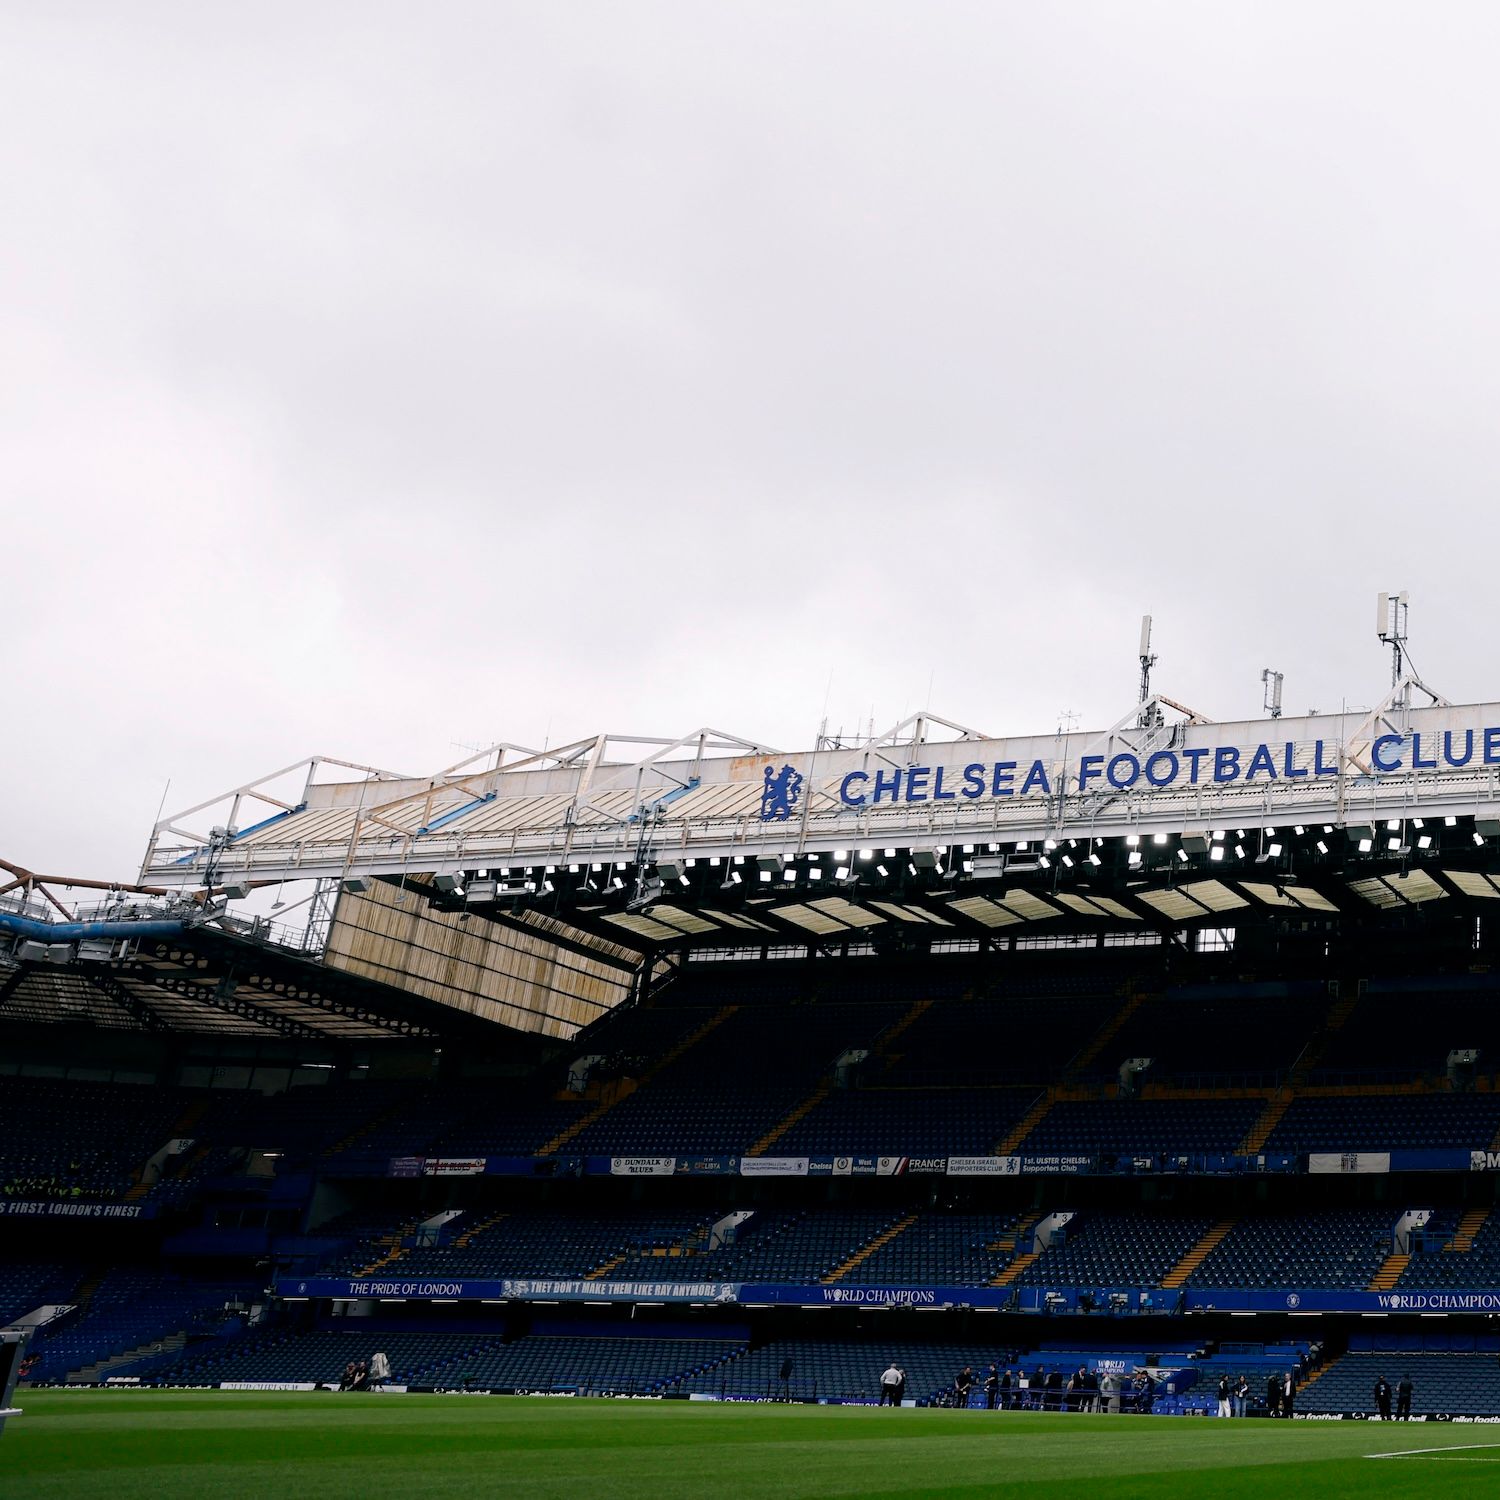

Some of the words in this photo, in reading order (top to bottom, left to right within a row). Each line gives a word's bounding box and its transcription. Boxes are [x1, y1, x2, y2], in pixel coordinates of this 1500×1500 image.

[840, 758, 1051, 807] CHELSEA
[1079, 739, 1339, 792] FOOTBALL
[909, 1159, 946, 1168] FRANCE
[1023, 1165, 1059, 1173] Supporters
[8, 1202, 44, 1214] FIRST,
[48, 1203, 102, 1216] LONDON'S
[104, 1206, 142, 1217] FINEST
[1062, 1214, 1067, 1222] 3
[350, 1283, 369, 1294] THE
[370, 1283, 400, 1294] PRIDE
[402, 1284, 417, 1294] OF
[418, 1284, 463, 1295] LONDON
[531, 1282, 552, 1293] THEY
[553, 1282, 580, 1294] DON'T
[582, 1283, 607, 1294] MAKE
[608, 1283, 632, 1294] THEM
[634, 1284, 653, 1295] LIKE
[654, 1284, 672, 1296] RAY
[672, 1285, 716, 1296] ANYMORE
[824, 1289, 864, 1301] WORLD
[866, 1290, 934, 1302] CHAMPIONS
[1378, 1295, 1427, 1308] WORLD
